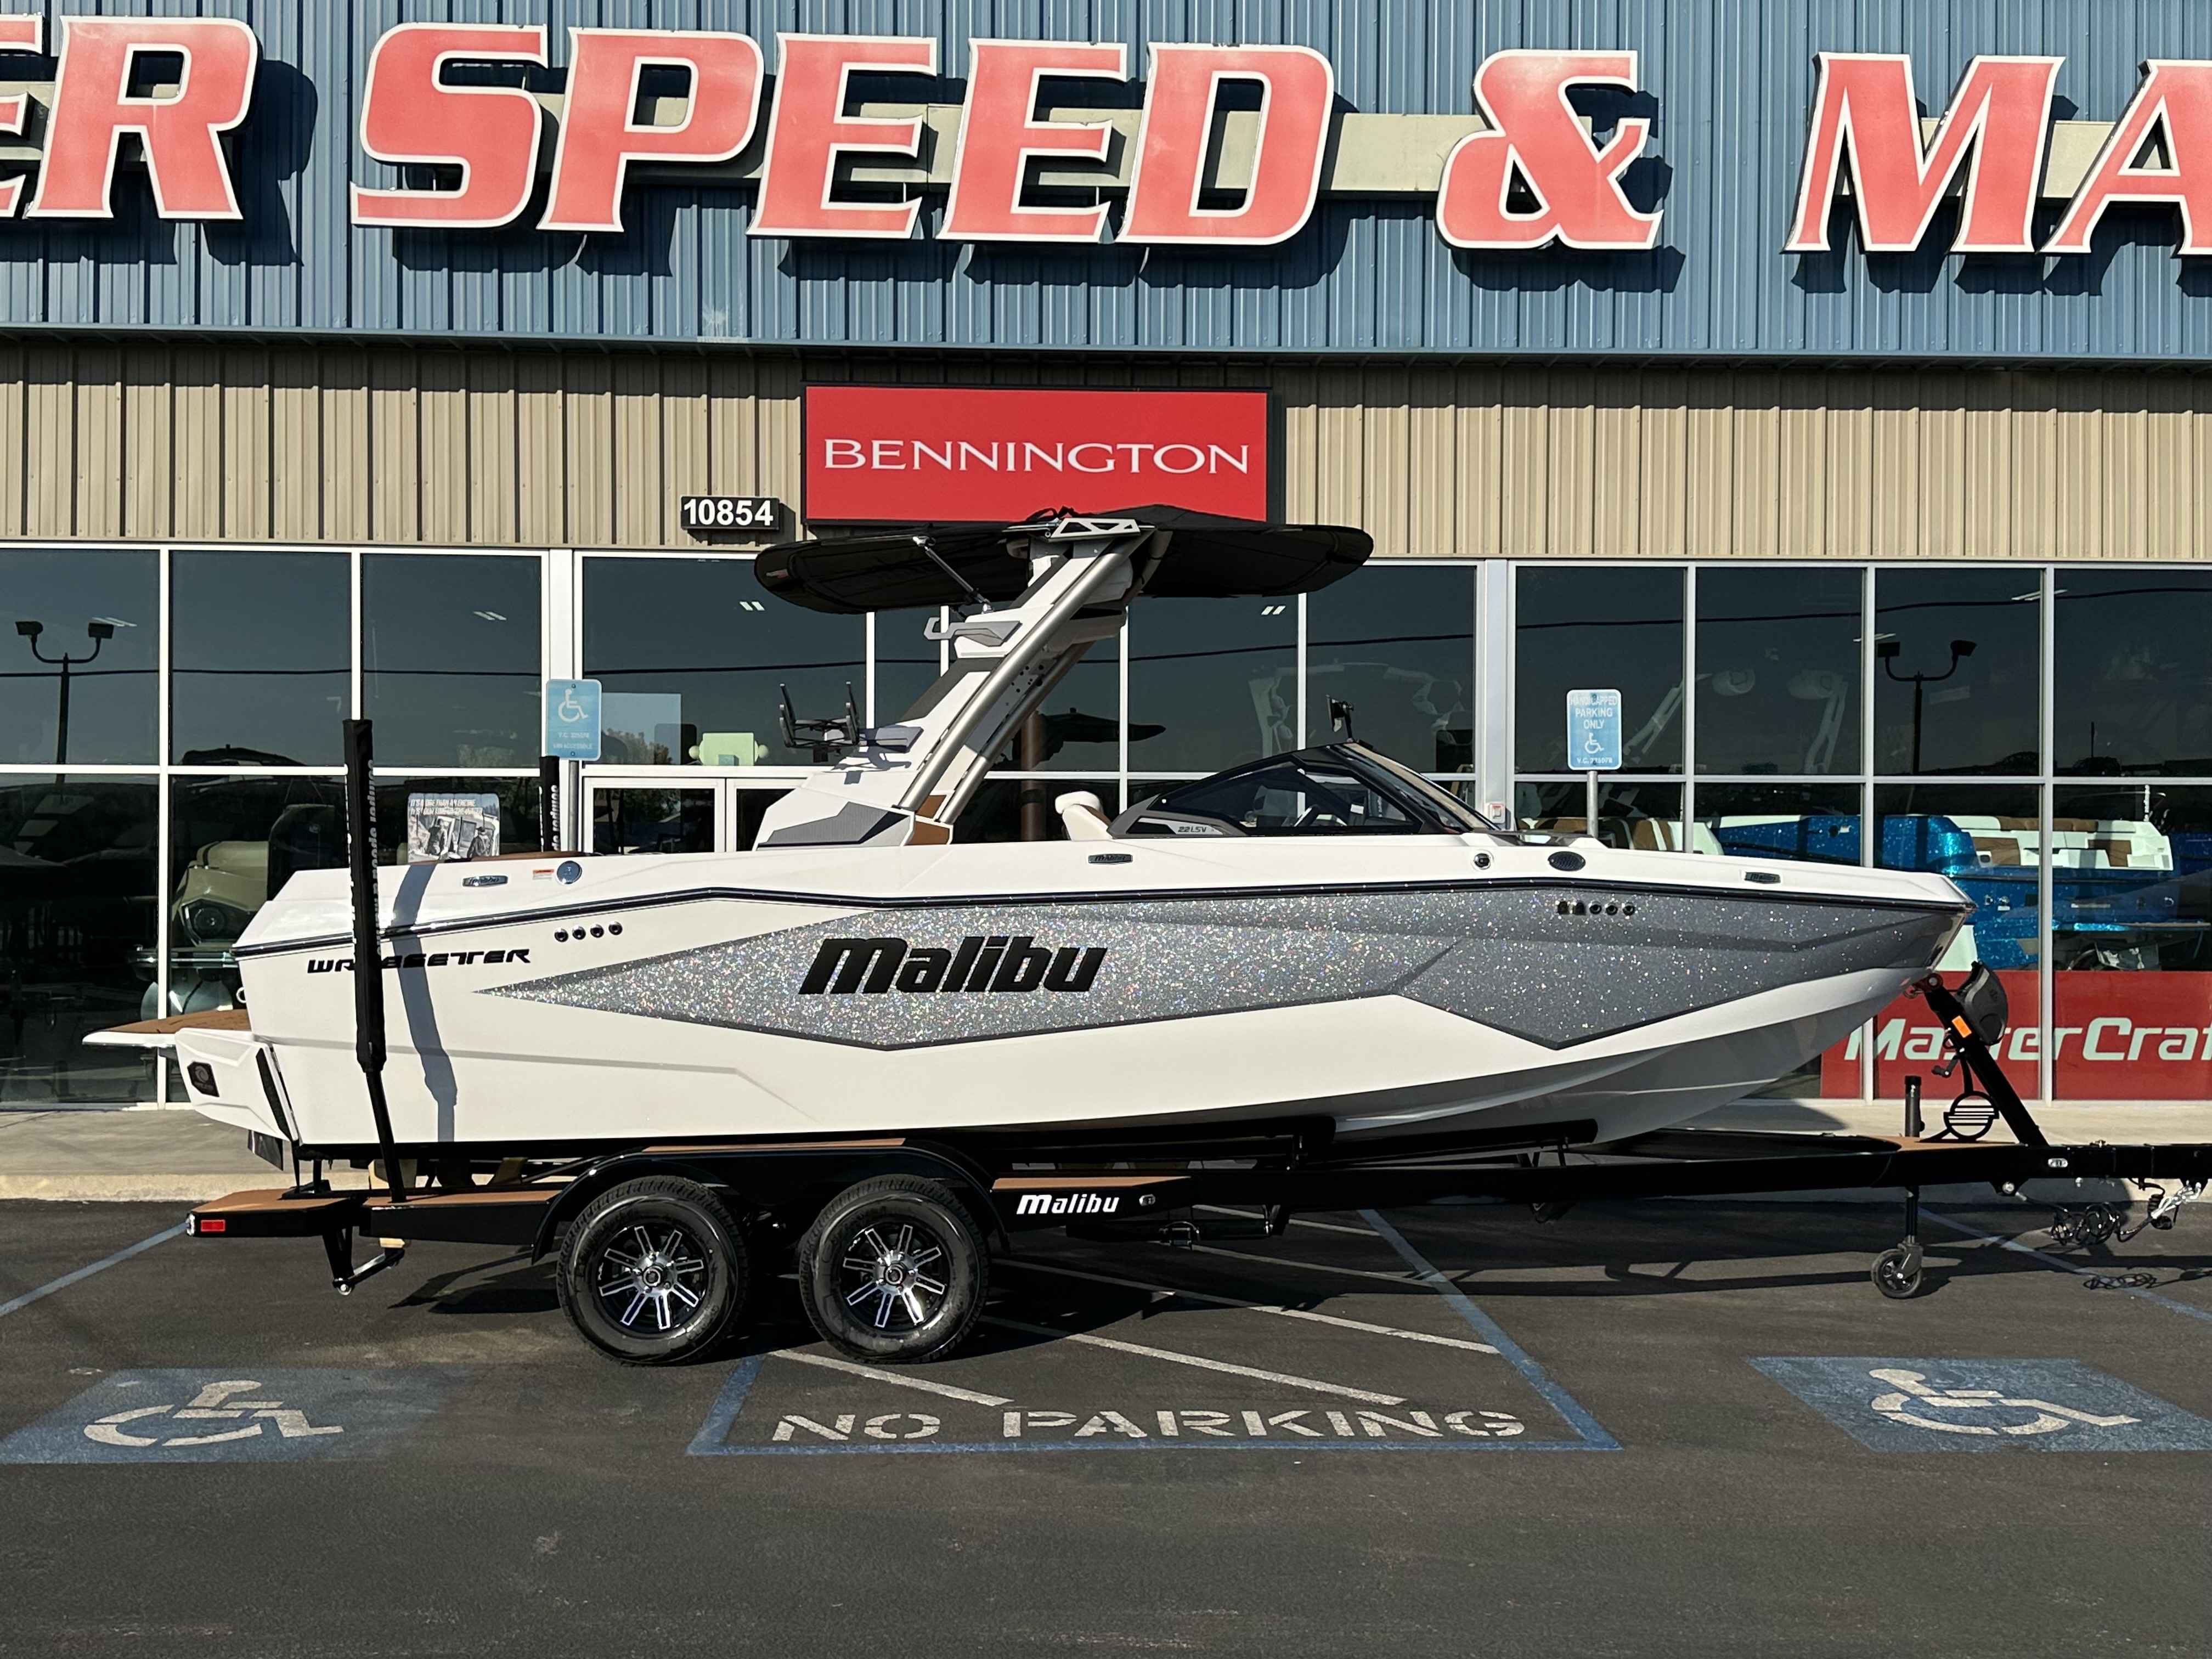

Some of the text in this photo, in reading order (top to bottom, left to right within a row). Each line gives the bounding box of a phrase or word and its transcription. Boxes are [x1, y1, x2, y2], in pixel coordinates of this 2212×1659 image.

[0, 14, 2212, 256] R SPEED & MA
[823, 438, 1250, 475] BENNINGTON
[684, 498, 774, 526] 10854
[1575, 707, 1613, 718] PARKING
[1583, 719, 1605, 730] ONLY
[307, 949, 531, 973] WAESETTER
[798, 936, 1108, 995] Malibu
[1843, 1017, 2212, 1061] MaerCra
[1016, 1193, 1120, 1215] Malibu
[771, 1409, 1526, 1442] NO PARKING
